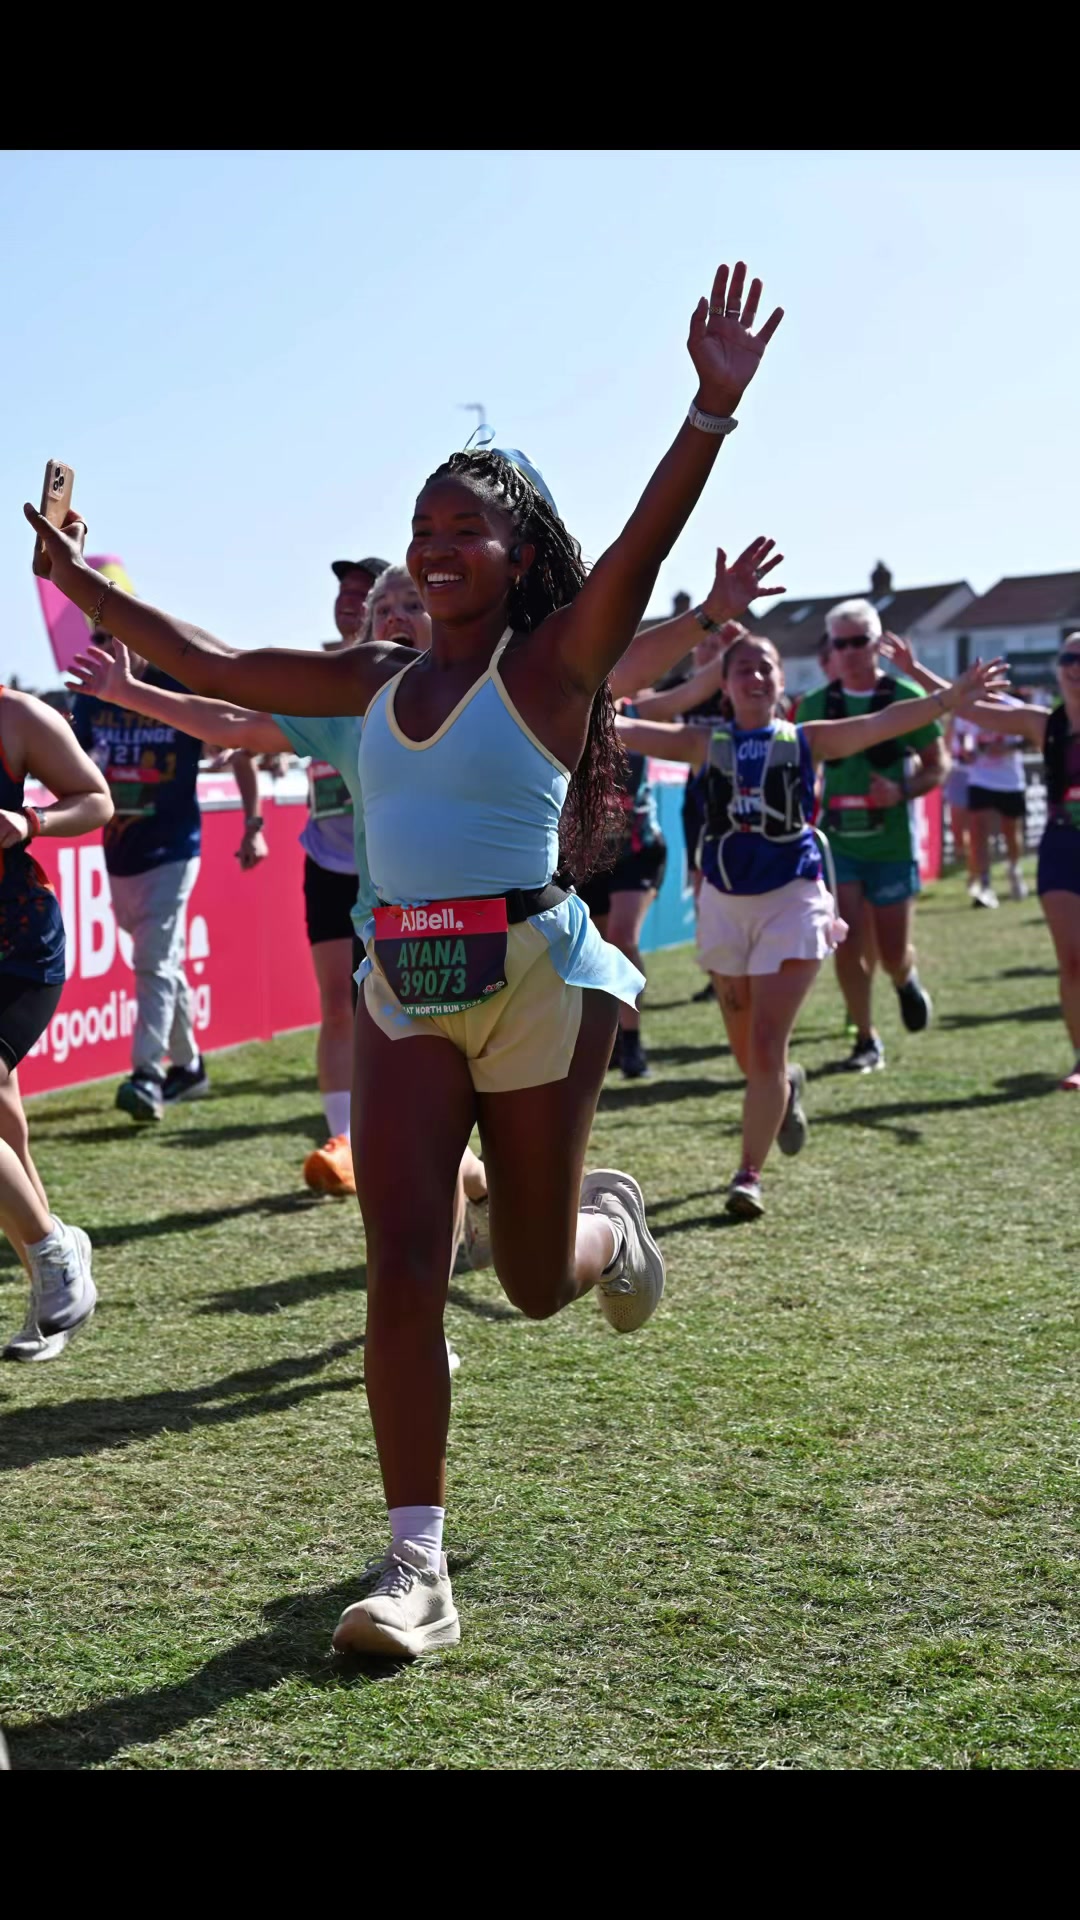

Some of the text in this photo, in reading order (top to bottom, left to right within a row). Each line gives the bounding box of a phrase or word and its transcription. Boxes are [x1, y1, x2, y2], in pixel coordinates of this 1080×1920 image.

[397, 939, 467, 969] AYANA
[400, 968, 467, 997] 39073
[415, 1005, 442, 1015] NORTH
[443, 1004, 460, 1013] RUN
[51, 990, 117, 1063] good
